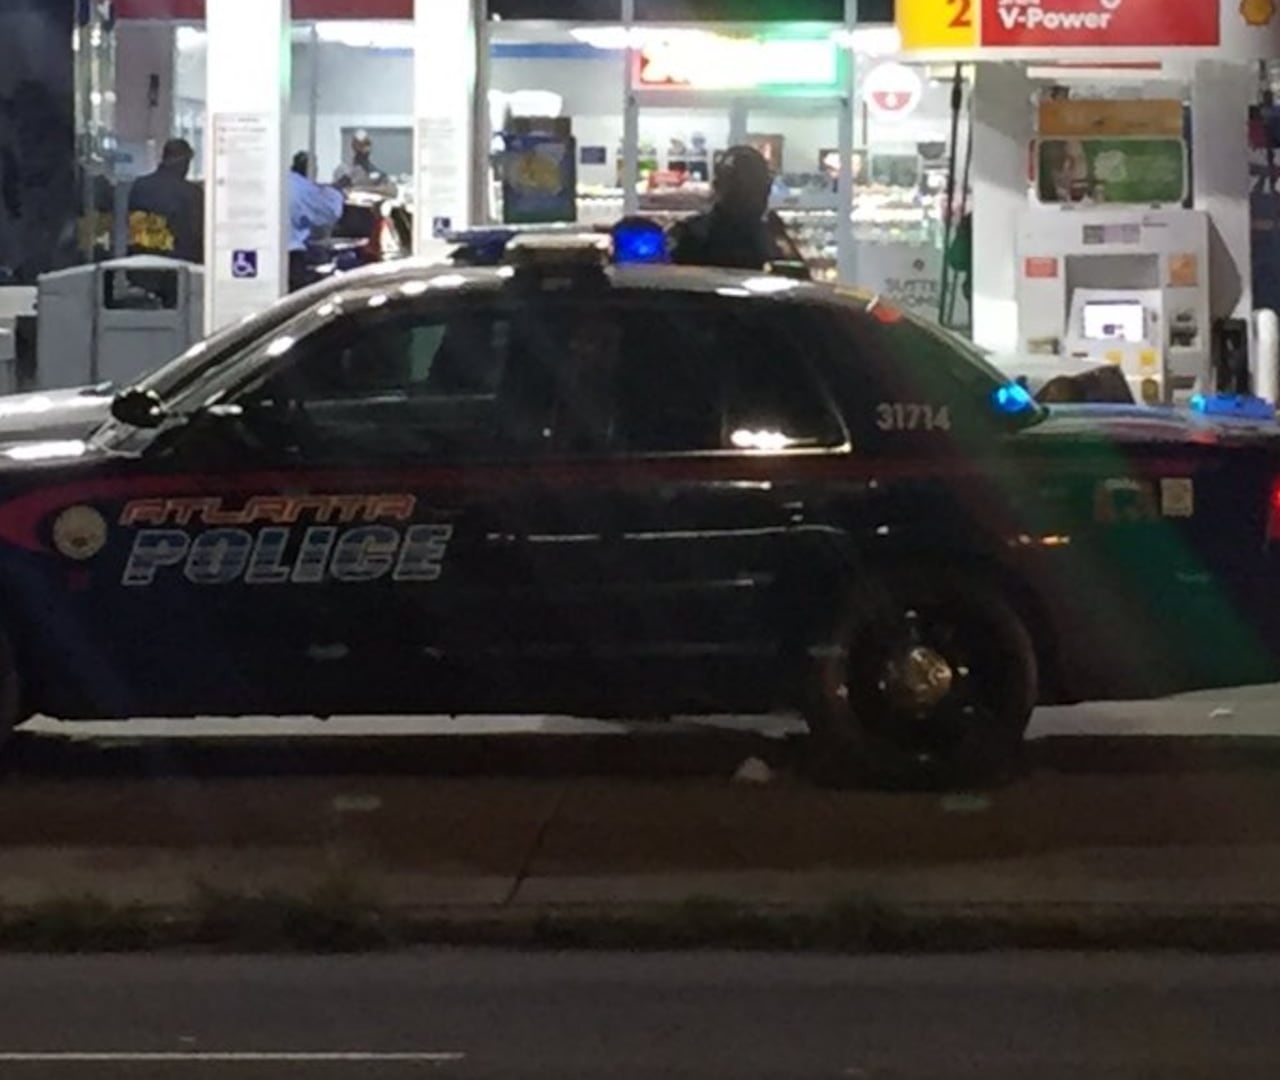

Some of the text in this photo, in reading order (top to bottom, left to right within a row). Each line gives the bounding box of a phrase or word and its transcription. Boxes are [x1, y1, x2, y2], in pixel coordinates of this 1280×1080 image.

[998, 7, 1112, 30] V-Power
[876, 402, 952, 431] 31714
[121, 493, 417, 525] ATLANTA
[122, 525, 453, 587] POLICE
